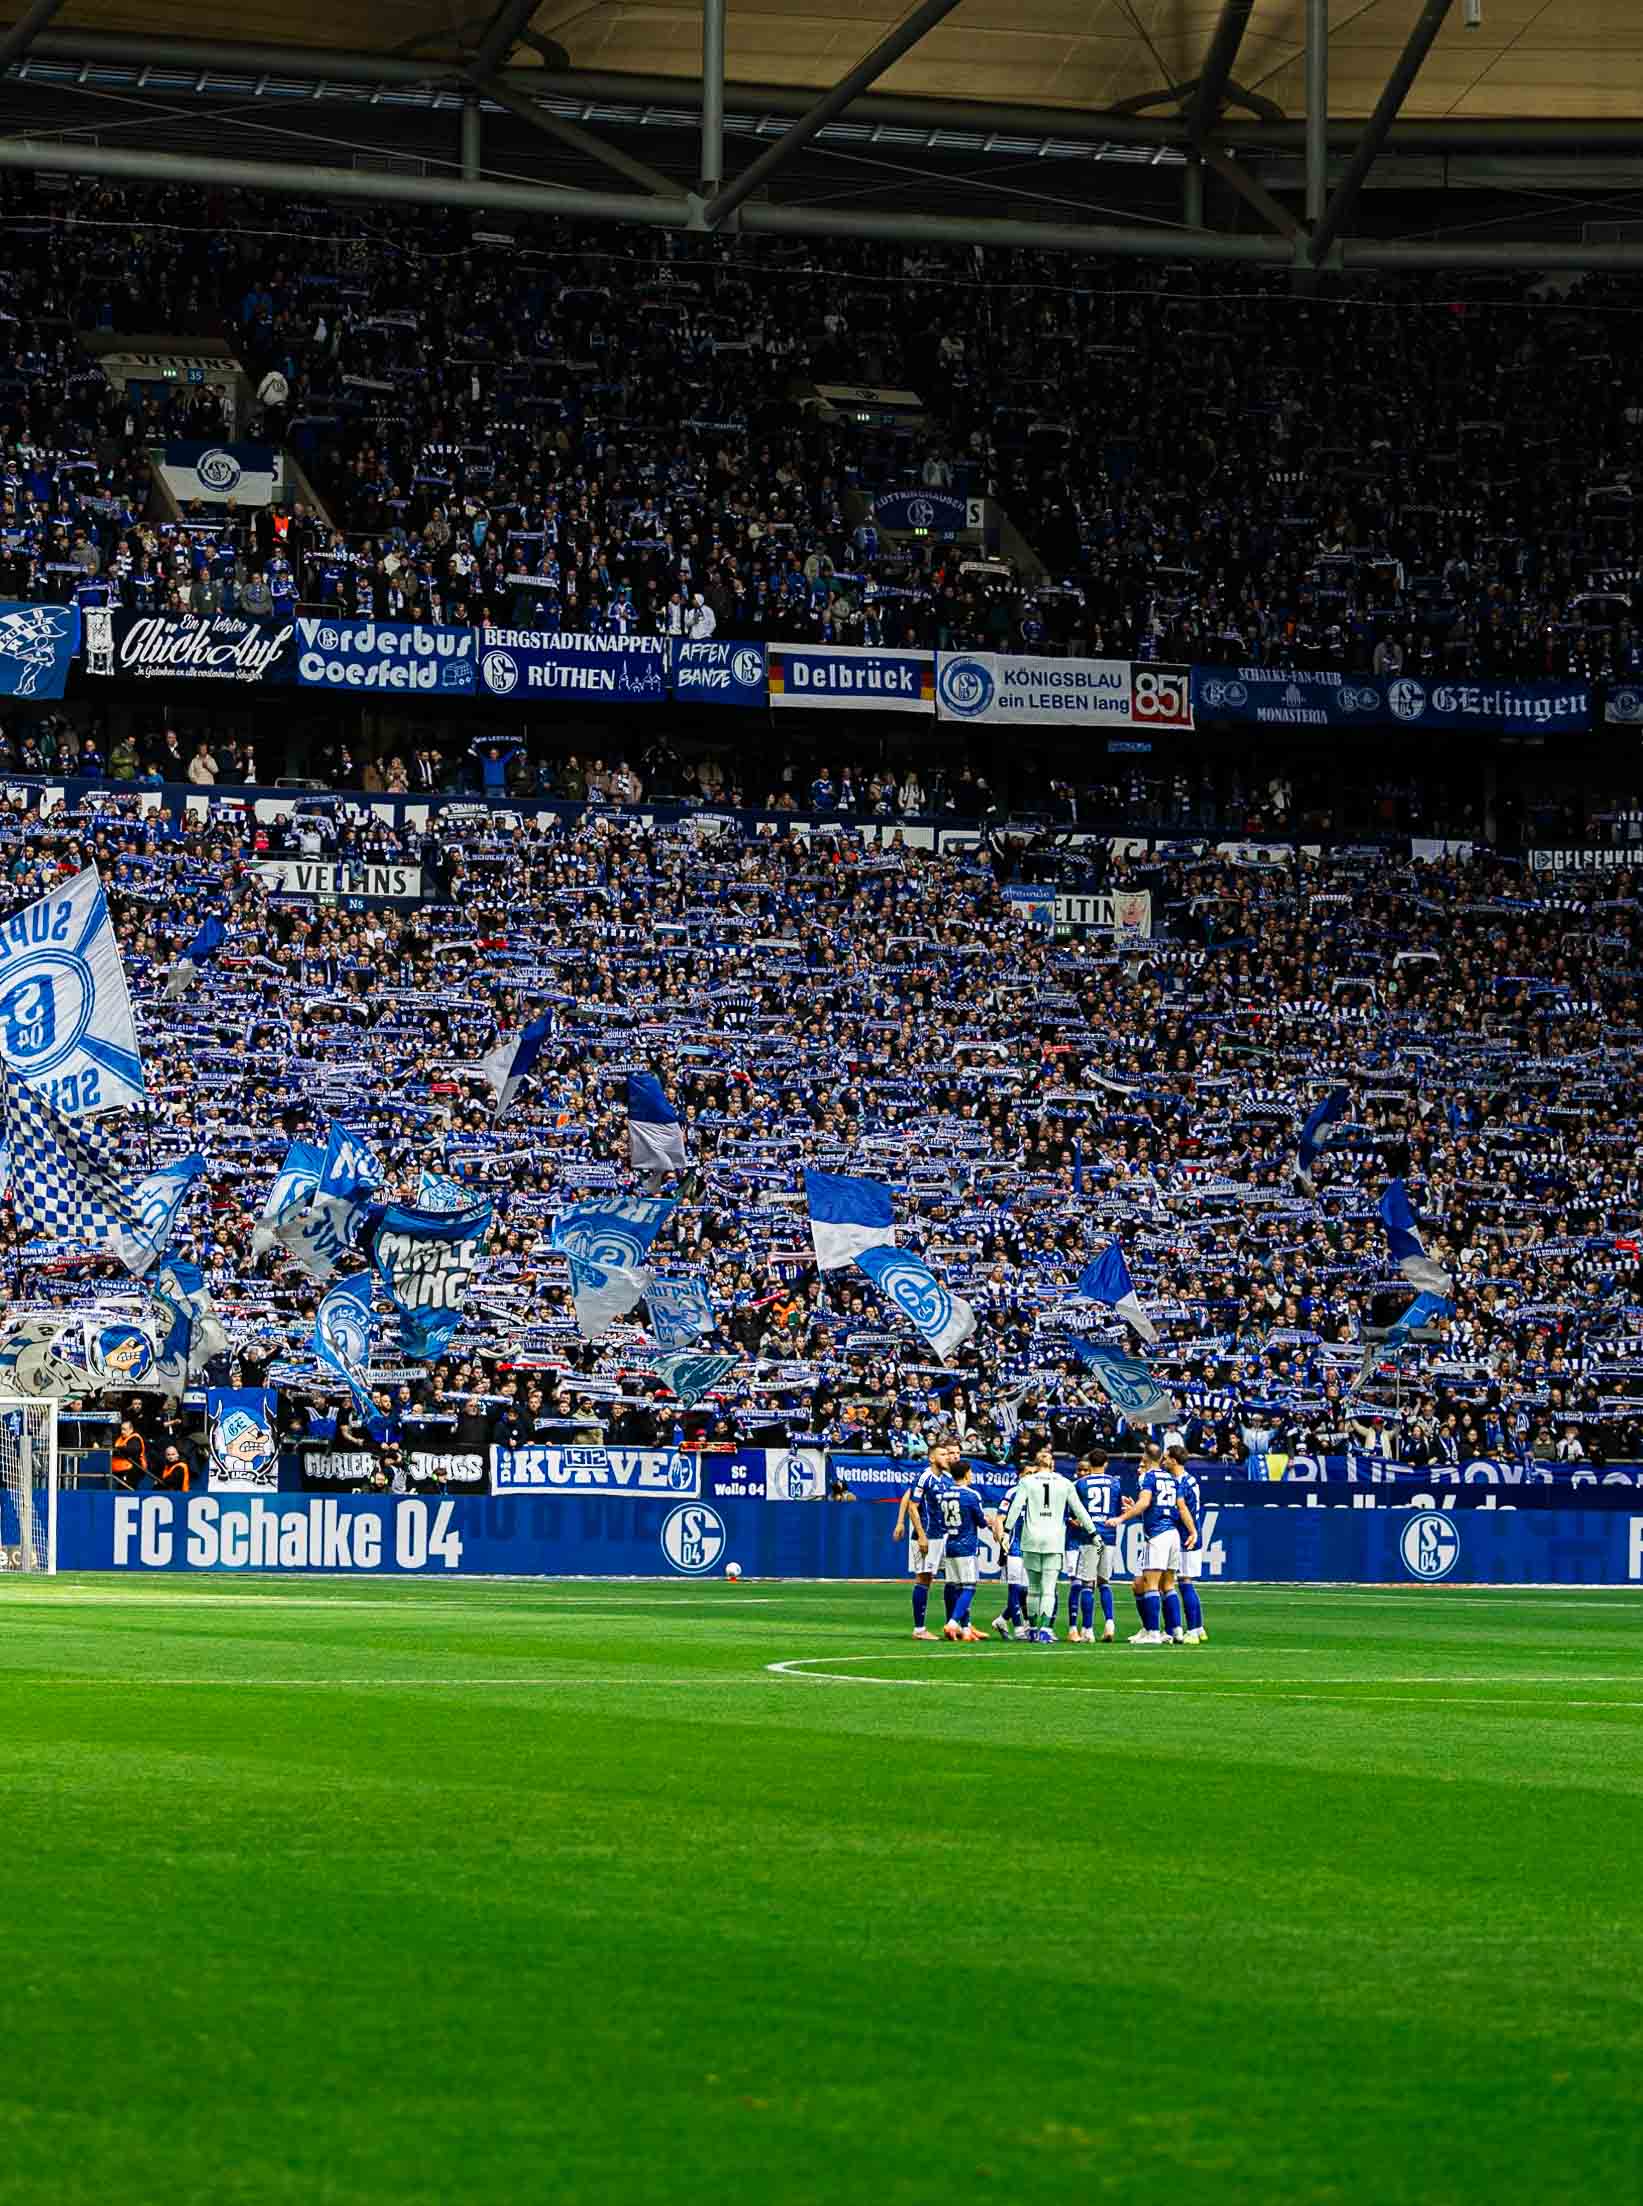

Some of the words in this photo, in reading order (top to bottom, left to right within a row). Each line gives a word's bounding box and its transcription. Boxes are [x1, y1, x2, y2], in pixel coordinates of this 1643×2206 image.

[180, 614, 200, 630] Ein
[120, 618, 212, 667] Glück
[485, 628, 664, 653] BERGSTADTKNAPPEN
[679, 643, 731, 664] AFFEN
[300, 652, 437, 688] Coesfeld
[528, 661, 615, 690] RÜTHEN
[678, 669, 731, 688] BANDE
[793, 661, 913, 690] Delbrück
[1004, 668, 1123, 689] KÖNIGSBLAU
[999, 695, 1025, 708] ein
[1029, 695, 1088, 709] LEBEN
[1094, 695, 1129, 713] lang
[350, 900, 363, 909] N5
[567, 1449, 607, 1466] 1312
[731, 1465, 747, 1479] SC
[985, 1472, 1017, 1486] 2002
[714, 1482, 747, 1496] Wolle
[1042, 1482, 1050, 1508] 1
[1088, 1486, 1111, 1513] 21
[1155, 1479, 1177, 1506] 25
[113, 1496, 173, 1566] FC
[186, 1496, 382, 1568] Schalke
[396, 1499, 463, 1568] 04
